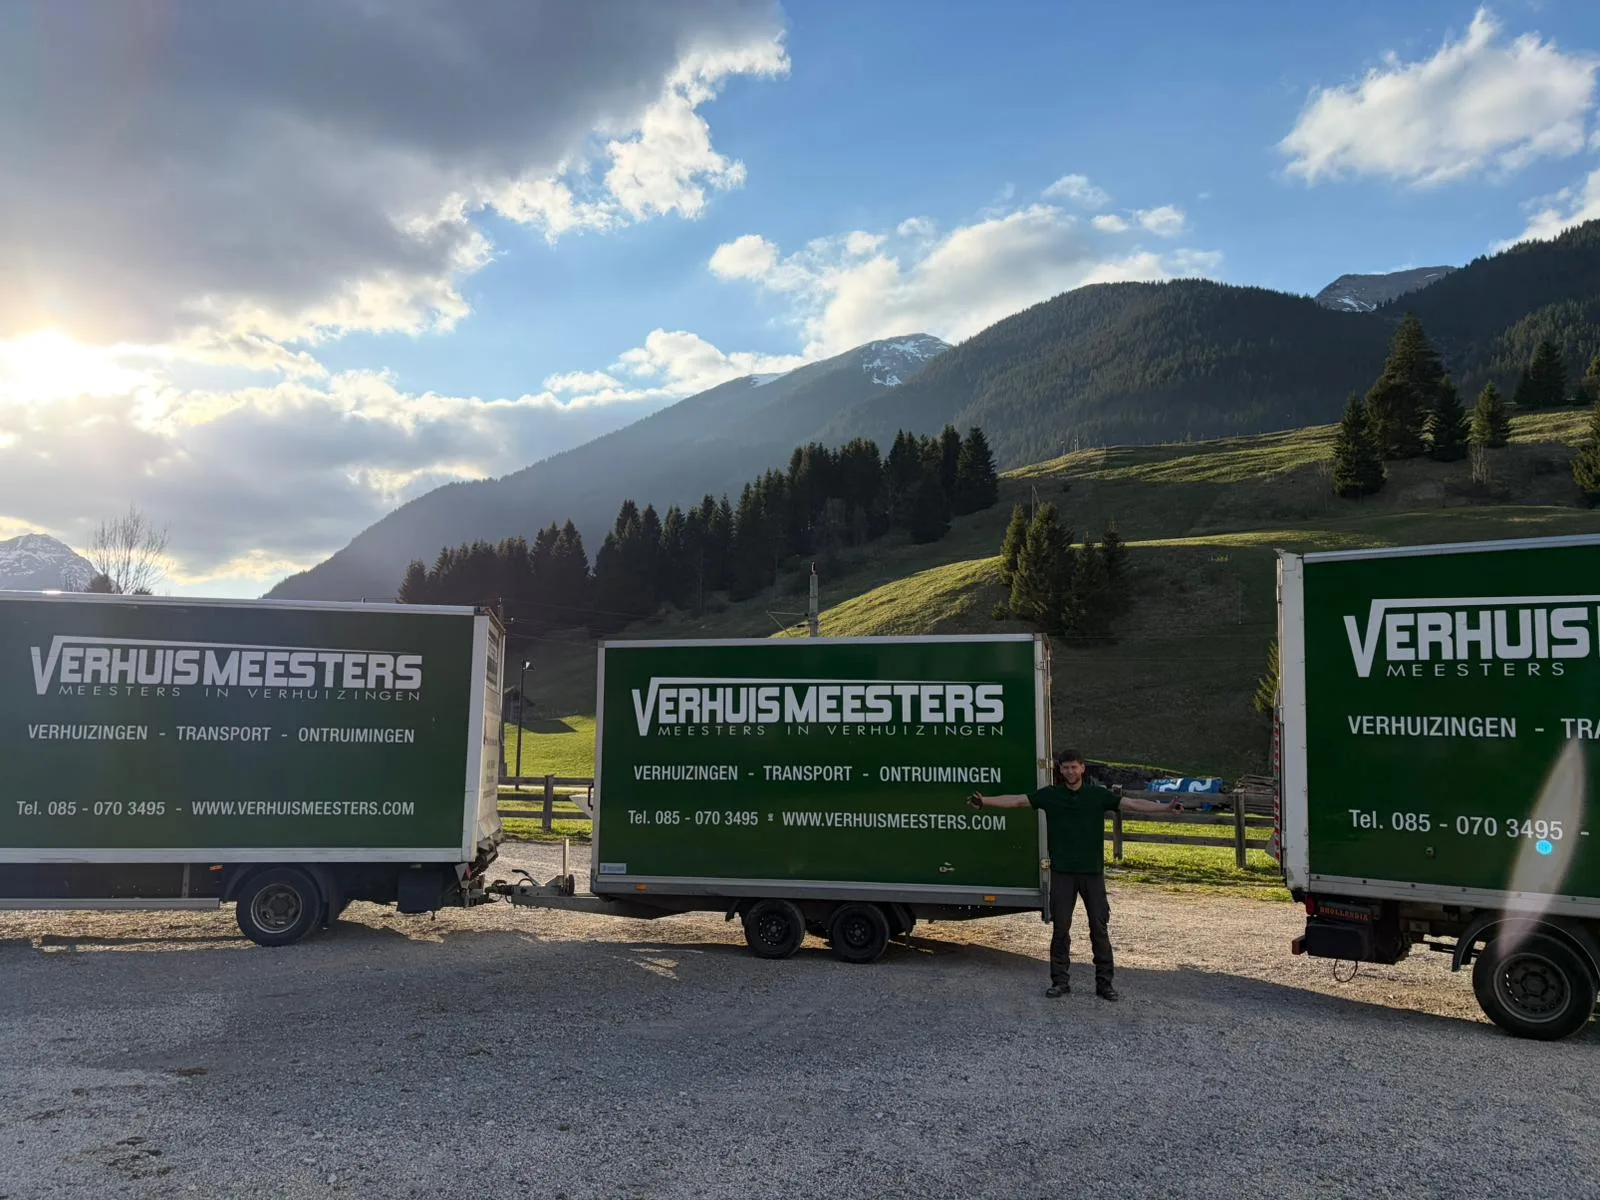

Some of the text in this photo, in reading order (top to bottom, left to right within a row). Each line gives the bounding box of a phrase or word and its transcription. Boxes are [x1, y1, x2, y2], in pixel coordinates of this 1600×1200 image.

[1342, 594, 1600, 679] VERHUIS
[1386, 662, 1565, 678] MEESTERS
[58, 684, 421, 702] MEESTERS IN VERHUIZINGEN
[28, 723, 148, 741] VERHUIZINGEN
[175, 725, 272, 743] TRANSPORT
[298, 727, 415, 744] ONTRUIMINGEN
[657, 725, 1004, 737] MEESTERS IN VERHUIZINGEN
[1347, 714, 1517, 738] VERHUIZINGEN
[633, 764, 738, 781] VERHUIZINGEN
[762, 765, 853, 782] TRANSPORT
[879, 765, 1002, 784] ONTRUIMINGEN
[16, 800, 42, 816] Tel.
[47, 801, 77, 816] 085
[93, 801, 123, 816] 070
[127, 801, 166, 816] 3495
[191, 800, 415, 816] WWW.VERHUISMEESTERS.COM
[627, 809, 651, 825] Tel.
[655, 810, 681, 825] 085
[694, 810, 721, 826] 070
[724, 810, 759, 826] 3495
[781, 810, 1007, 831] WWW.VERHUISMEESTERS.COM
[1347, 808, 1384, 829] Tel.
[1391, 811, 1431, 833] 085
[1455, 815, 1498, 837] 070
[1505, 817, 1564, 841] 3495
